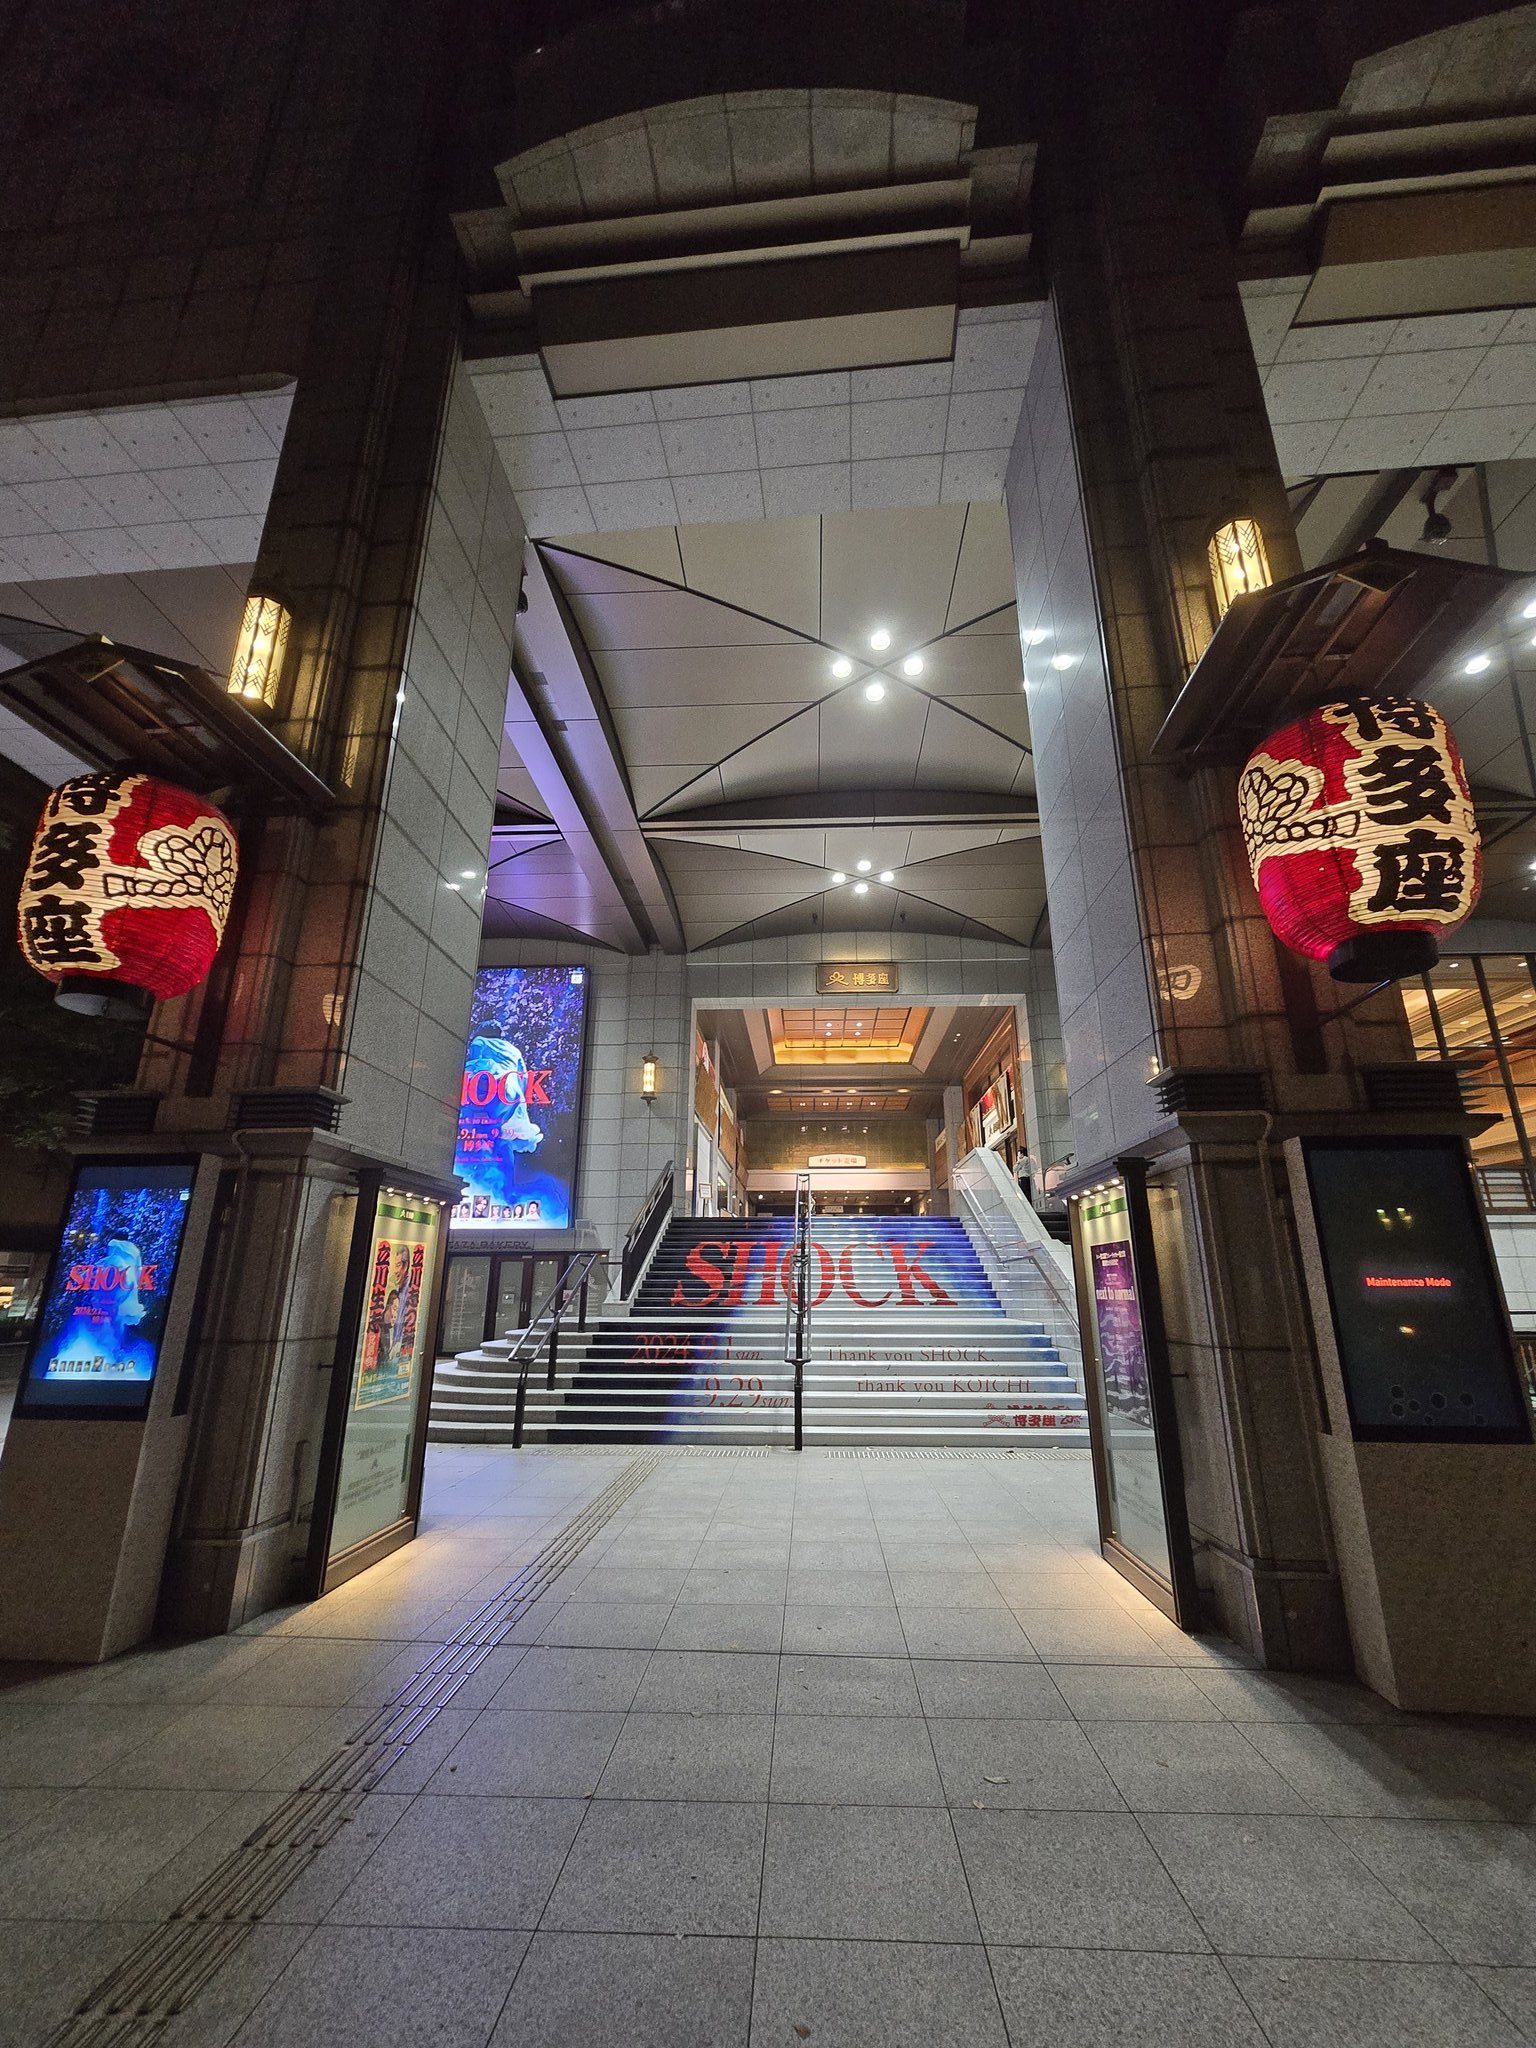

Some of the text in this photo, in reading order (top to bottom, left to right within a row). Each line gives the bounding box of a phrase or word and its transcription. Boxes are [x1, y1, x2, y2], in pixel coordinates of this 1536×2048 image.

[1332, 697, 1465, 913] 博多座
[24, 772, 121, 964] 博多座
[852, 972, 890, 986] 博多座
[65, 1264, 159, 1291] SHOCK
[671, 1241, 959, 1307] SHOCK
[1365, 1277, 1452, 1287] Maintenance Mode
[825, 1344, 877, 1362] Thank
[885, 1350, 914, 1369] you
[857, 1374, 907, 1393] thank
[914, 1381, 946, 1402] you
